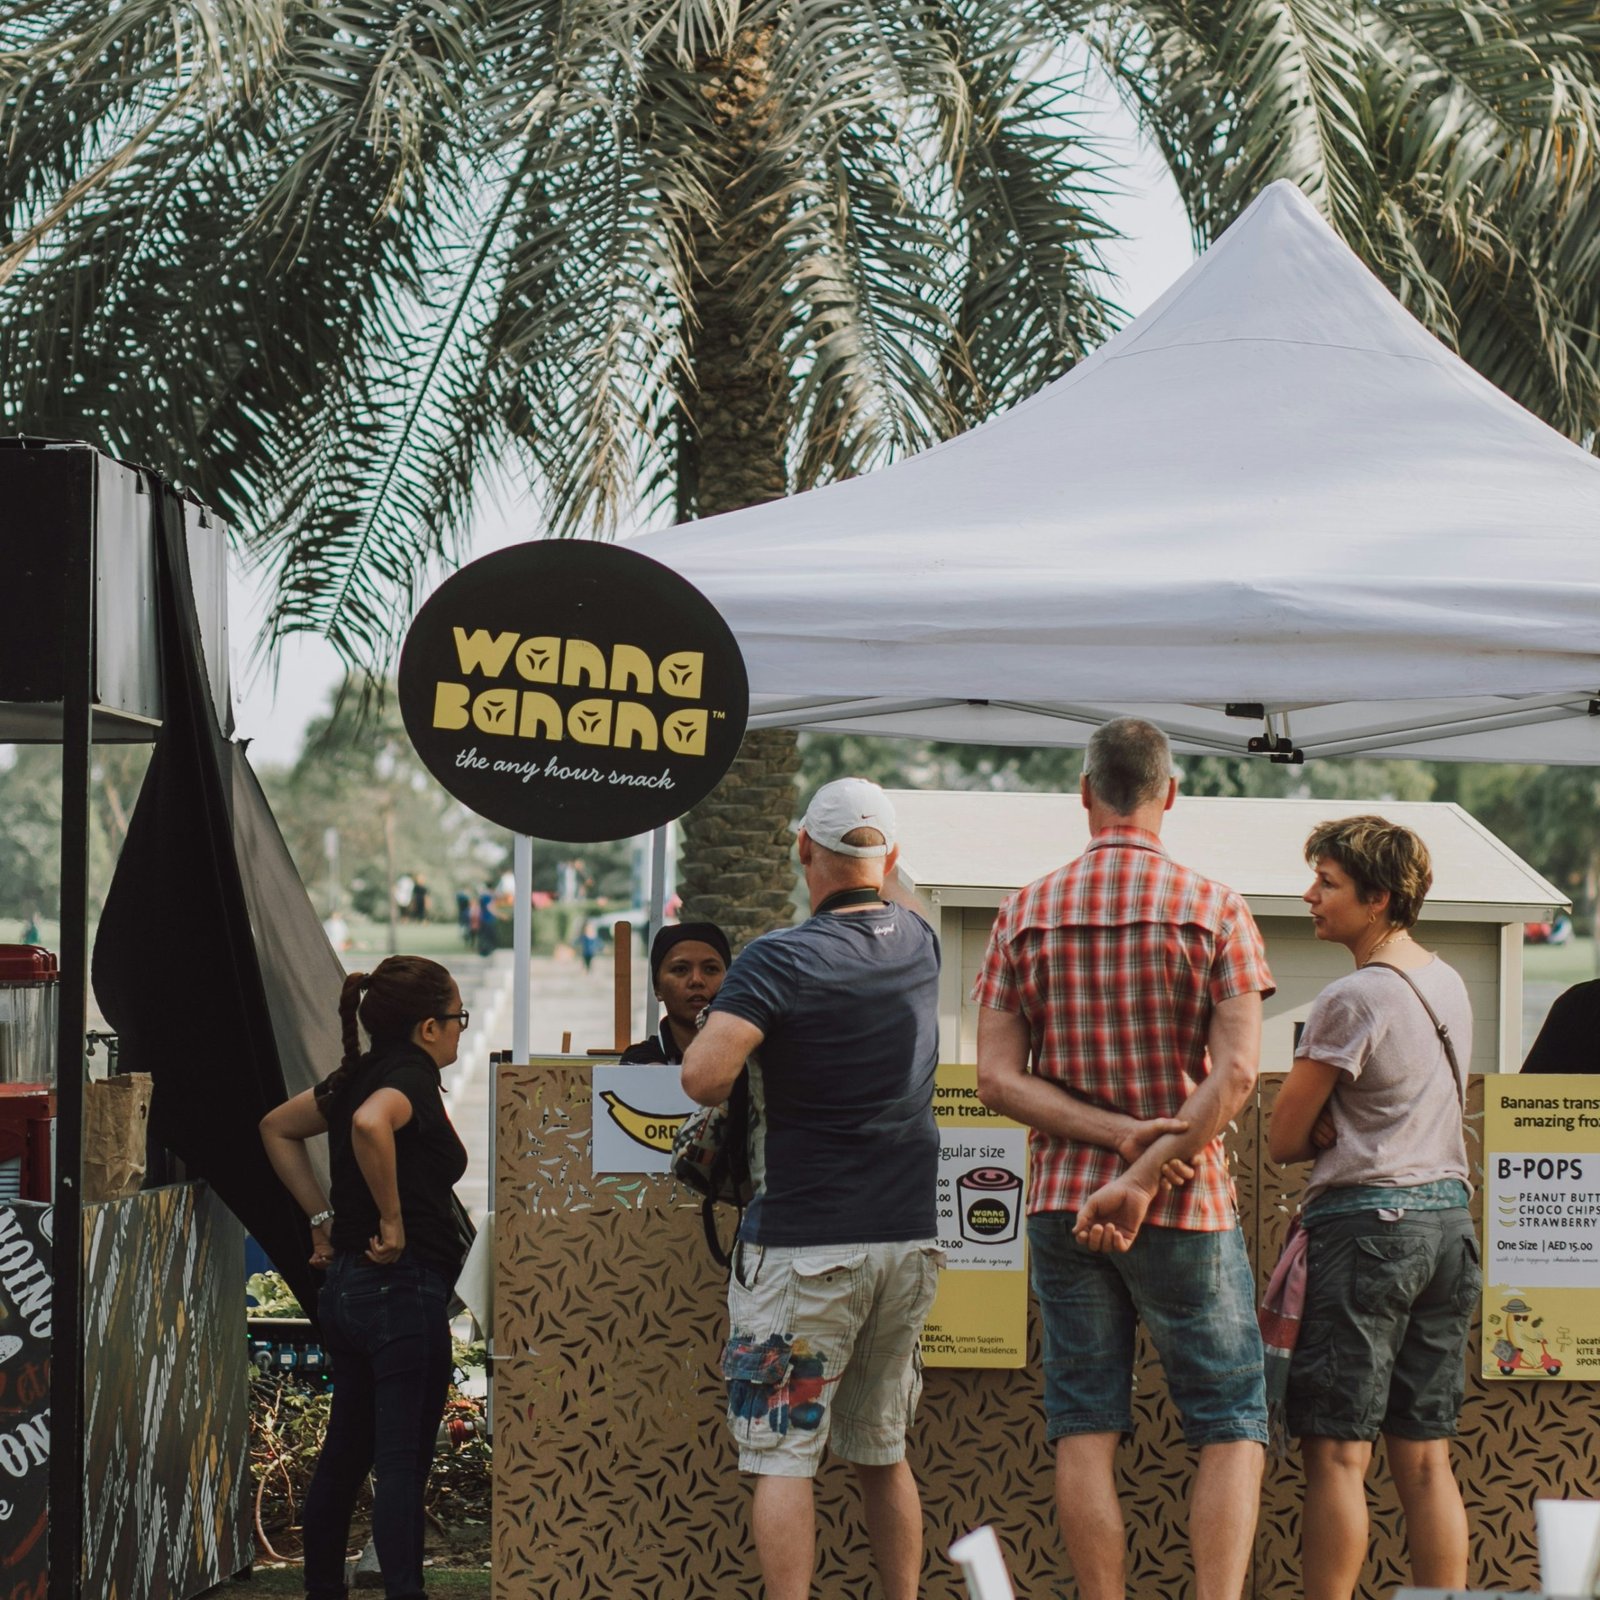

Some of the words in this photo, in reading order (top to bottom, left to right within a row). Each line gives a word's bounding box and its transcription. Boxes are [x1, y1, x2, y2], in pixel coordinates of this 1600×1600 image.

[455, 747, 489, 769] the
[493, 759, 540, 783] any
[544, 755, 604, 783] hour
[608, 768, 675, 789] snack
[934, 1084, 979, 1099] orme
[1501, 1096, 1559, 1109] Bananas
[1563, 1097, 1600, 1109] trans
[1514, 1114, 1575, 1131] amazing
[1578, 1114, 1600, 1127] fro
[980, 1145, 1005, 1158] size
[1498, 1158, 1582, 1180] B-POPS
[1520, 1193, 1566, 1202] PEANUT
[1519, 1205, 1562, 1215] CHOCO
[1519, 1218, 1597, 1227] STRAWBERRY
[940, 1240, 963, 1249] 21.00
[1497, 1240, 1517, 1250] One
[1519, 1240, 1538, 1250] Size
[1548, 1241, 1567, 1250] AED
[1569, 1242, 1593, 1253] 15.00
[925, 1335, 954, 1344] BEACH,
[937, 1345, 957, 1354] CITY,
[958, 1346, 978, 1354] Canal
[979, 1346, 1018, 1354] Residences
[1576, 1347, 1594, 1355] KITE
